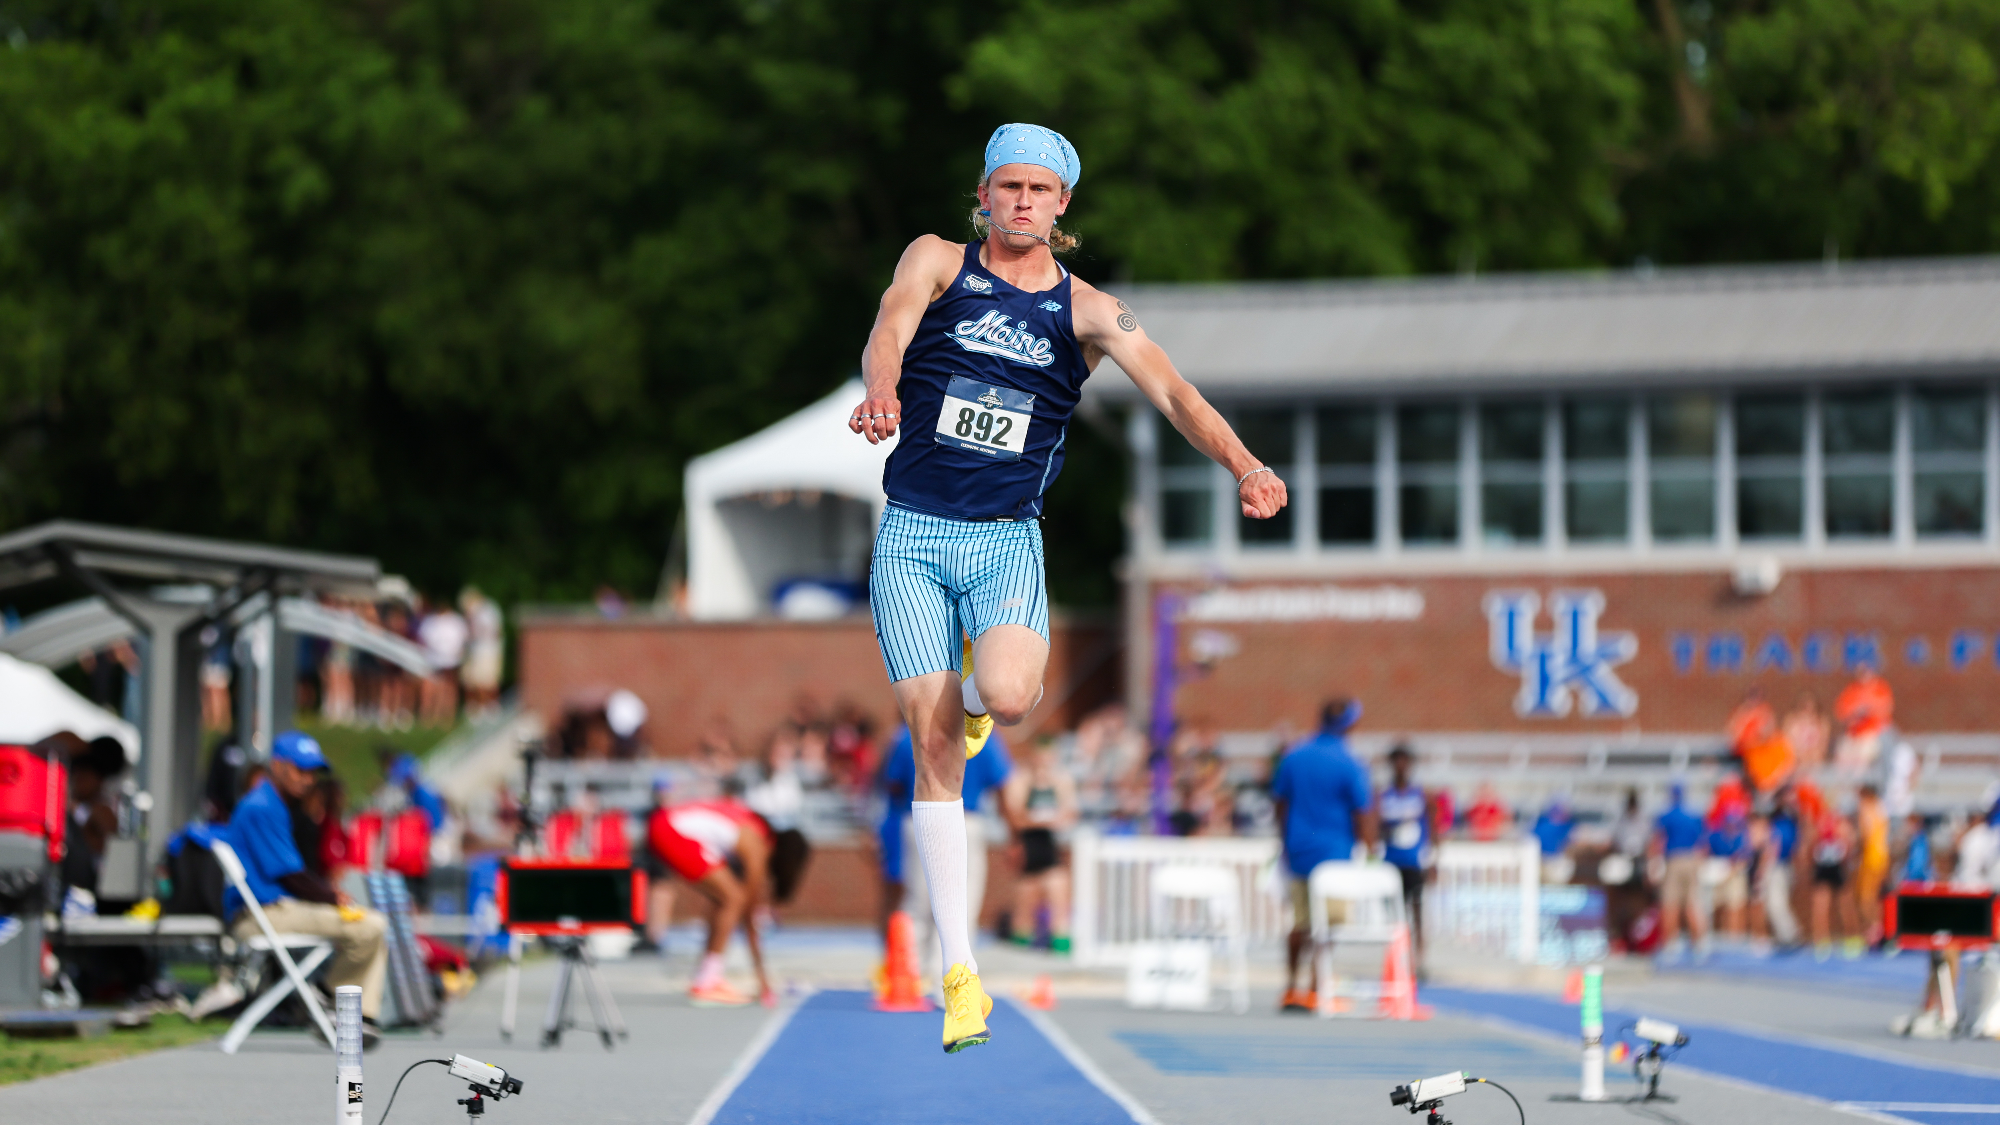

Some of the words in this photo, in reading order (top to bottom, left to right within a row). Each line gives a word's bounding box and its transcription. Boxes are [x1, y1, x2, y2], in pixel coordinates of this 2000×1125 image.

[951, 309, 1055, 367] Maine
[955, 407, 1013, 447] 892
[1481, 587, 1639, 719] UK
